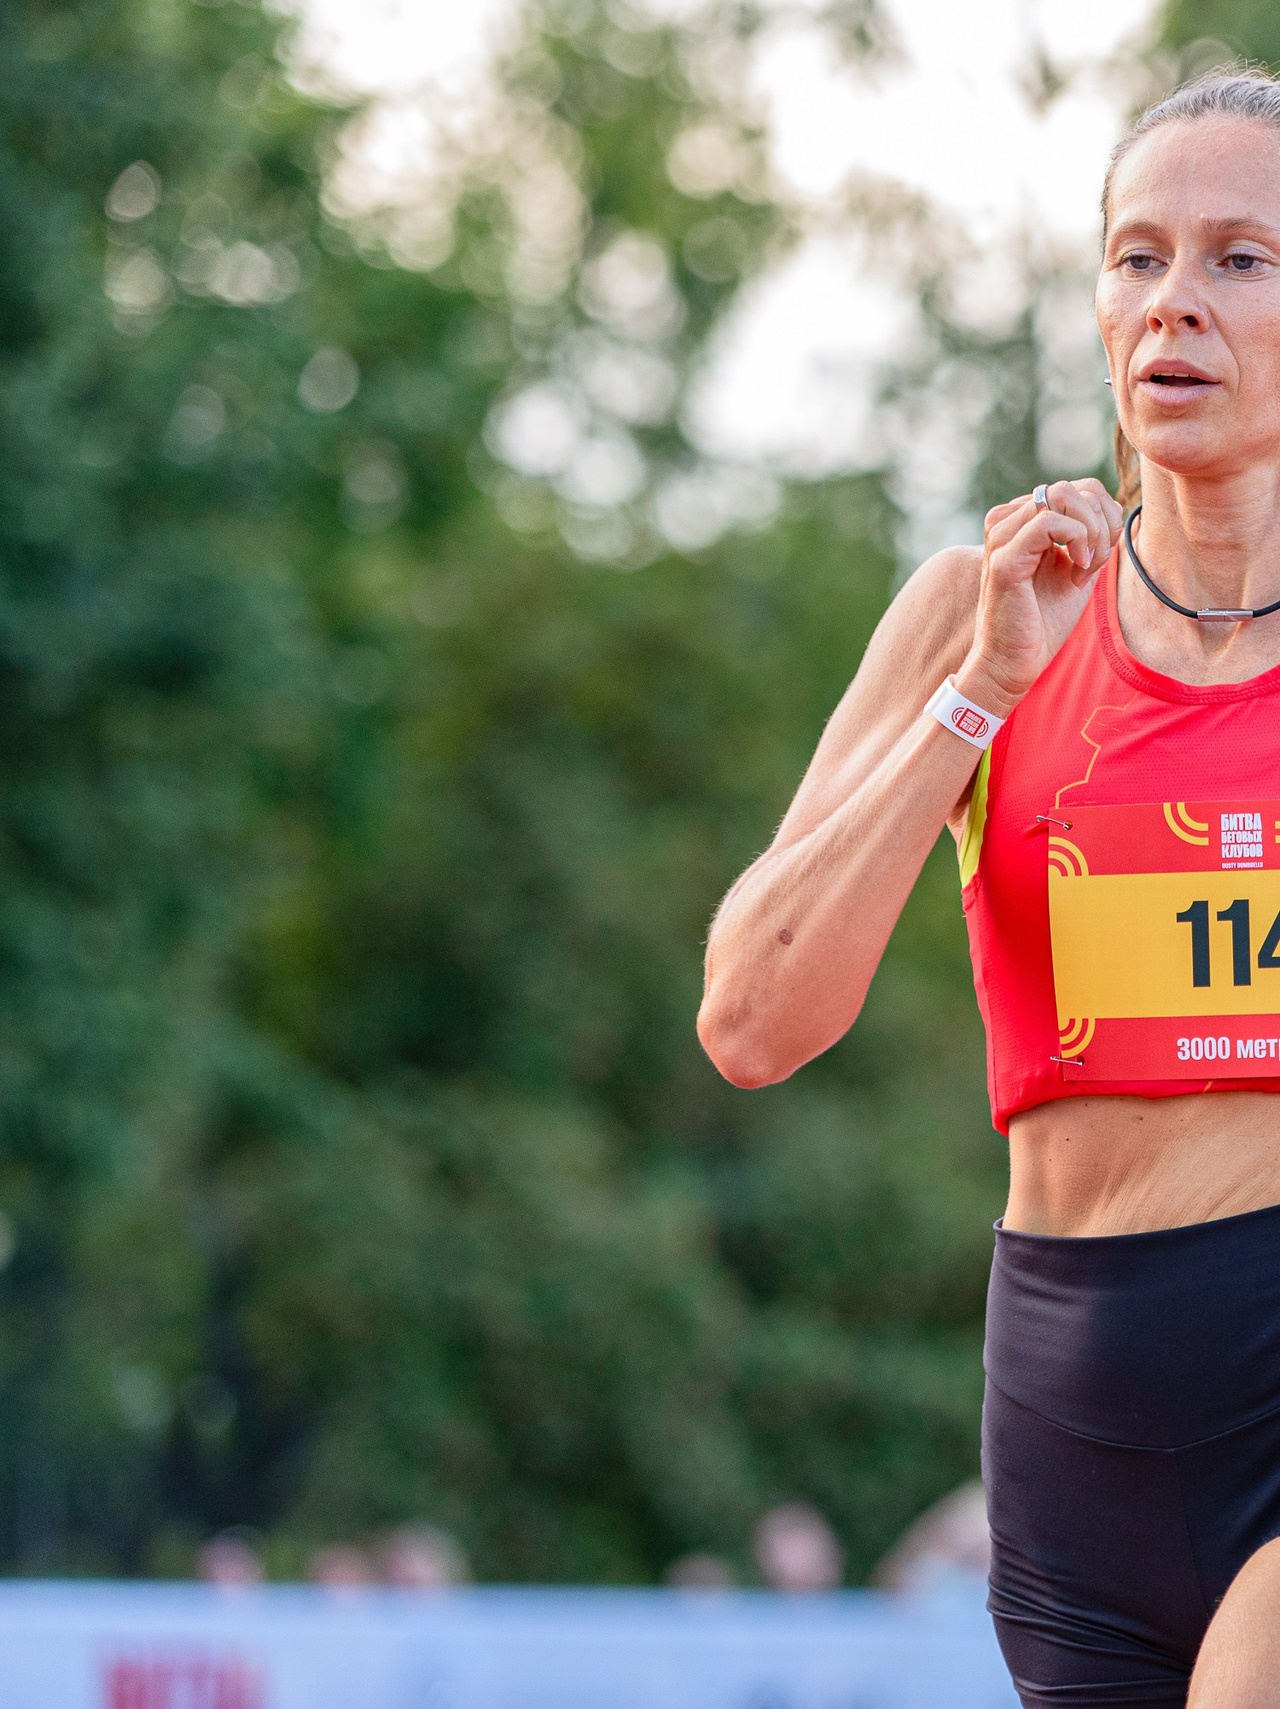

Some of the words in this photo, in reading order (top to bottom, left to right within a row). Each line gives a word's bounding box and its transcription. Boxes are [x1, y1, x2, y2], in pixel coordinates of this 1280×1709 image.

[1220, 812, 1263, 831] БИТВА
[1221, 830, 1263, 844] БЕГОВЫХ
[1221, 843, 1264, 859] КЛУБОВ
[1176, 1036, 1231, 1061] 3000
